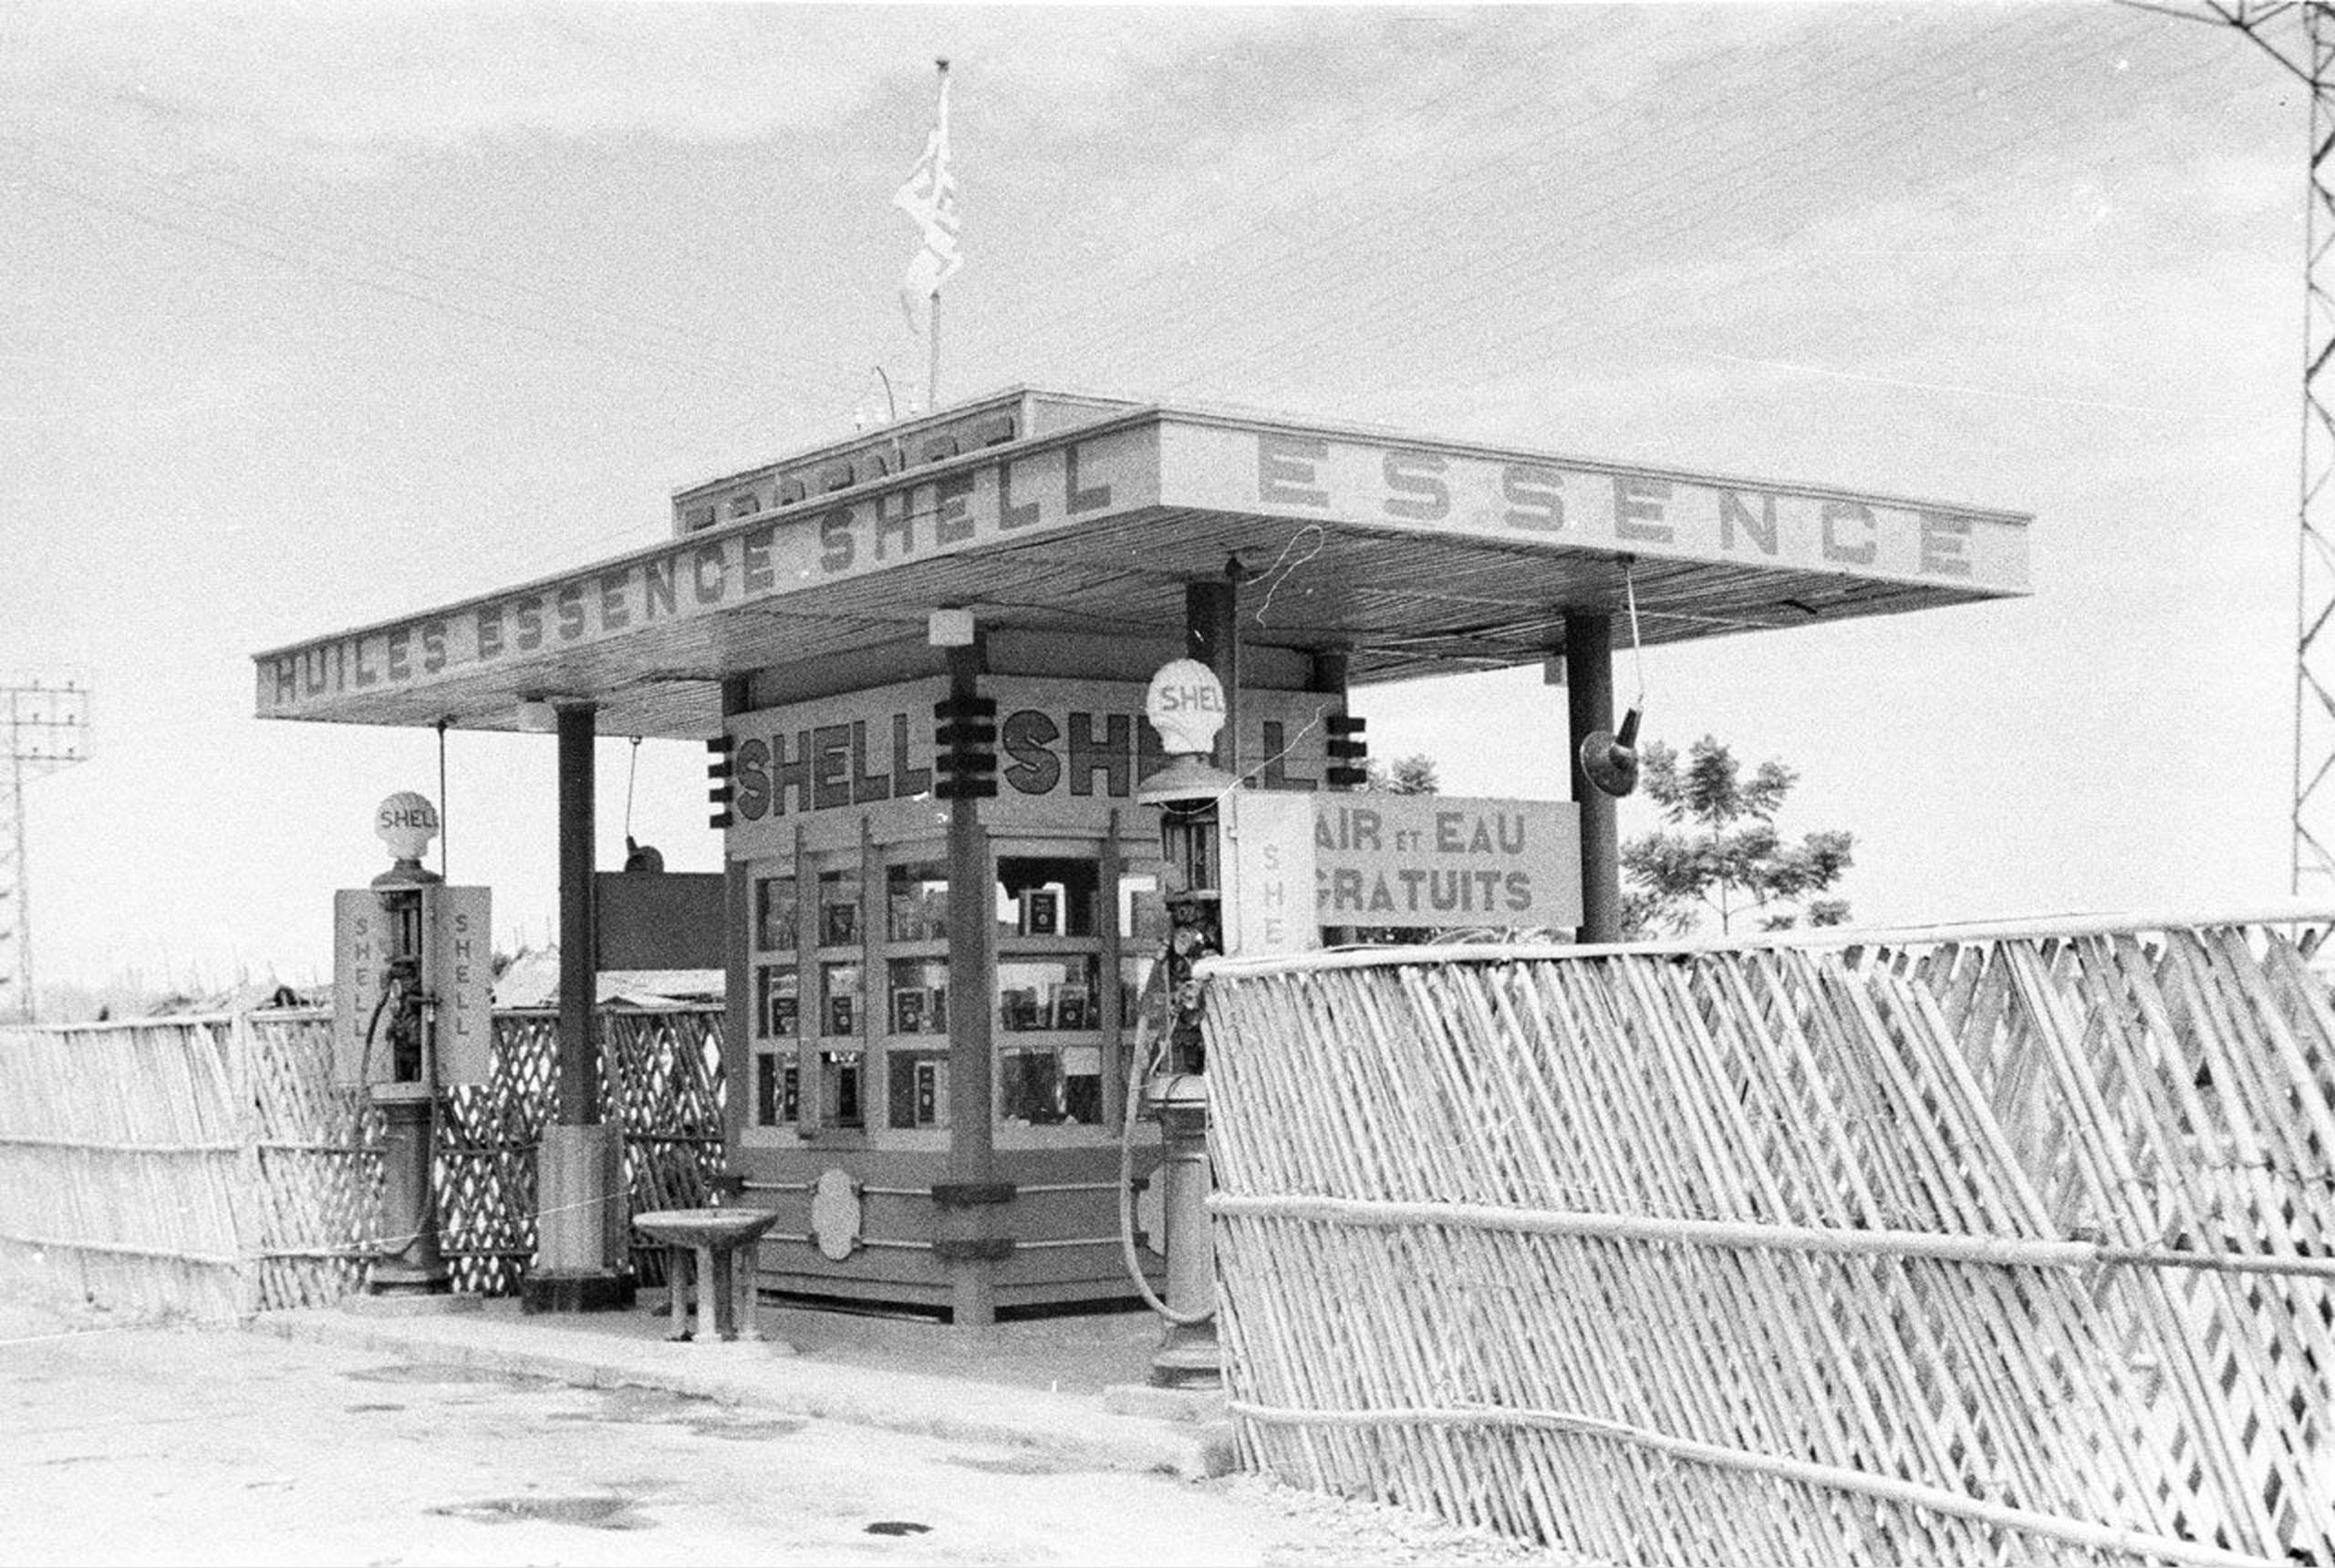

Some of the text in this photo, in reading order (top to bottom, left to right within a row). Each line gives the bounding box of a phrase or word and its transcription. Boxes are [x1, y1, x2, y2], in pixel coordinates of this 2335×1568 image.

[1258, 432, 1976, 576] ESSENCE
[275, 619, 448, 703] HUILES
[476, 526, 775, 662] ESSENCE
[820, 445, 1112, 573] SHELL
[735, 713, 932, 822] SHELL
[1001, 709, 1319, 797] SHL
[1315, 808, 1526, 856] AIR ET EAU
[355, 918, 371, 1038] SHELL
[455, 914, 471, 1036] SHELL
